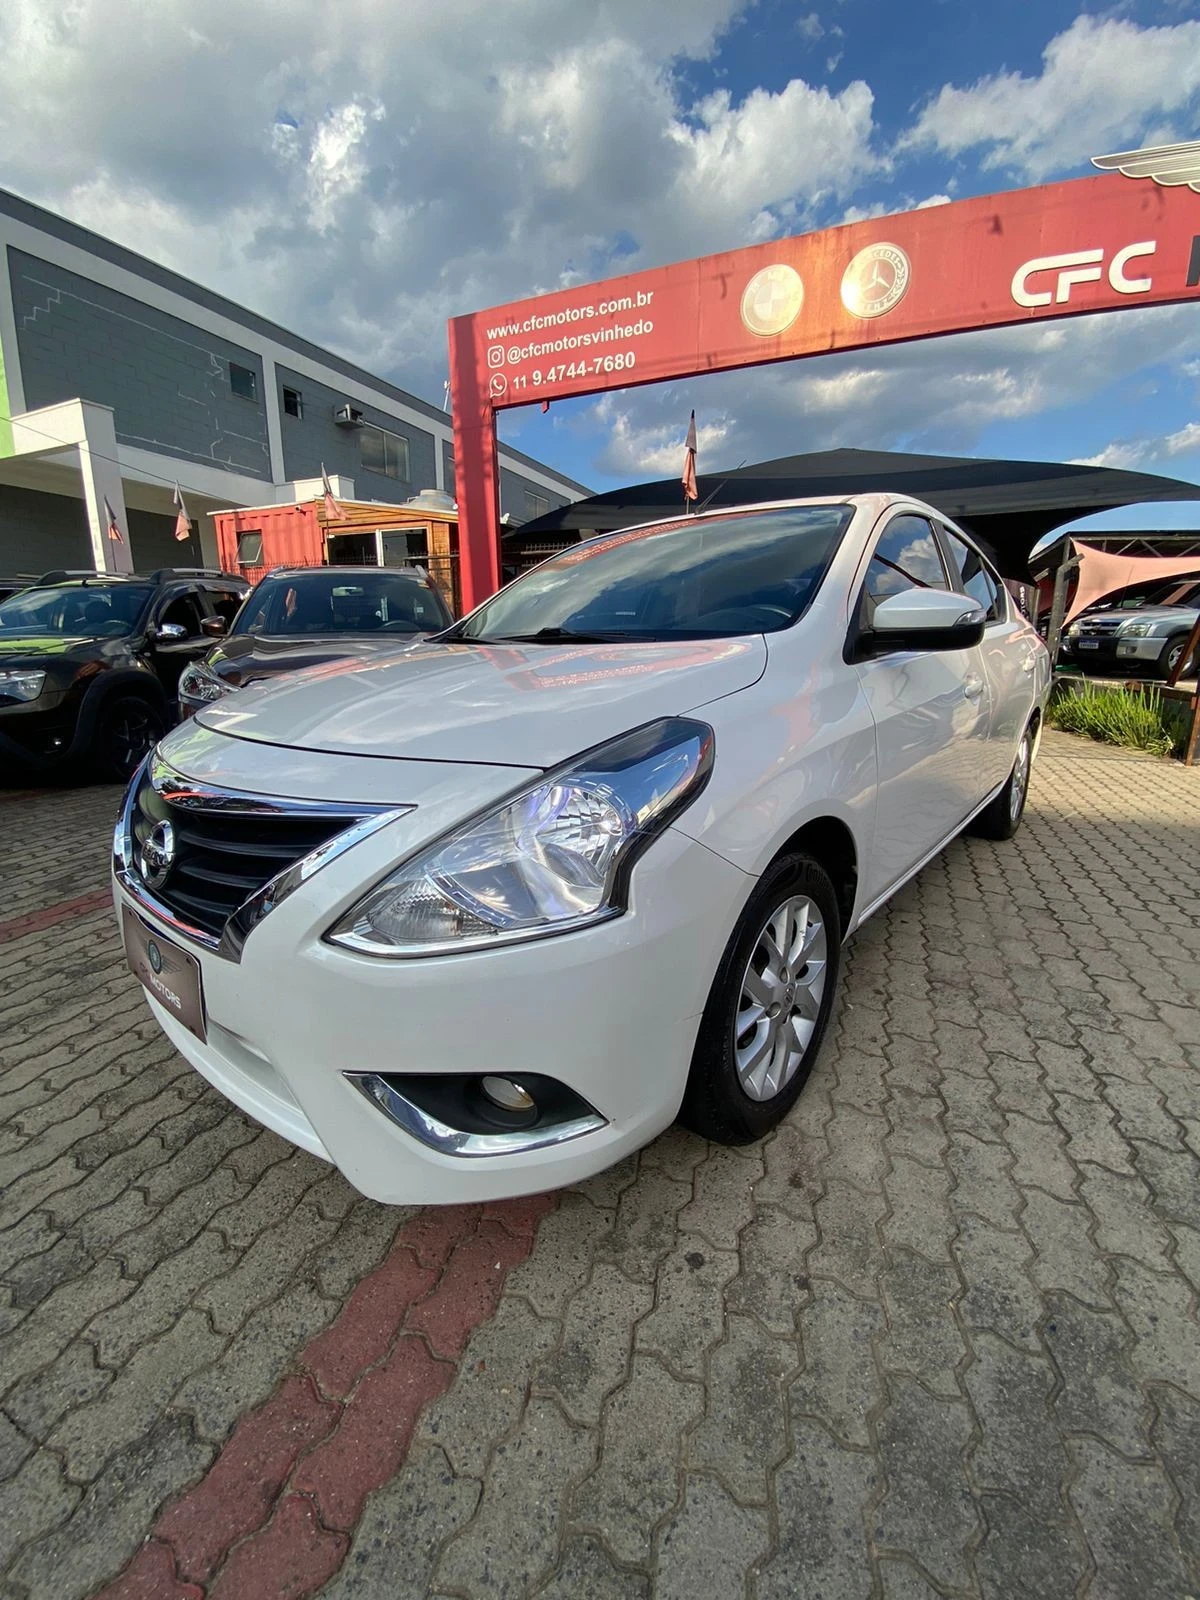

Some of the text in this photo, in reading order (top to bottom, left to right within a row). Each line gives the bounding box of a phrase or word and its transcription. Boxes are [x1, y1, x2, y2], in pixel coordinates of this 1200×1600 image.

[1011, 240, 1157, 308] CFC
[487, 291, 654, 340] www.cfcmotors.com.br
[507, 319, 654, 365] @cfcmotorsvinhedo
[513, 351, 636, 390] 11 9.4744-7680
[149, 974, 182, 1009] MOTORS
